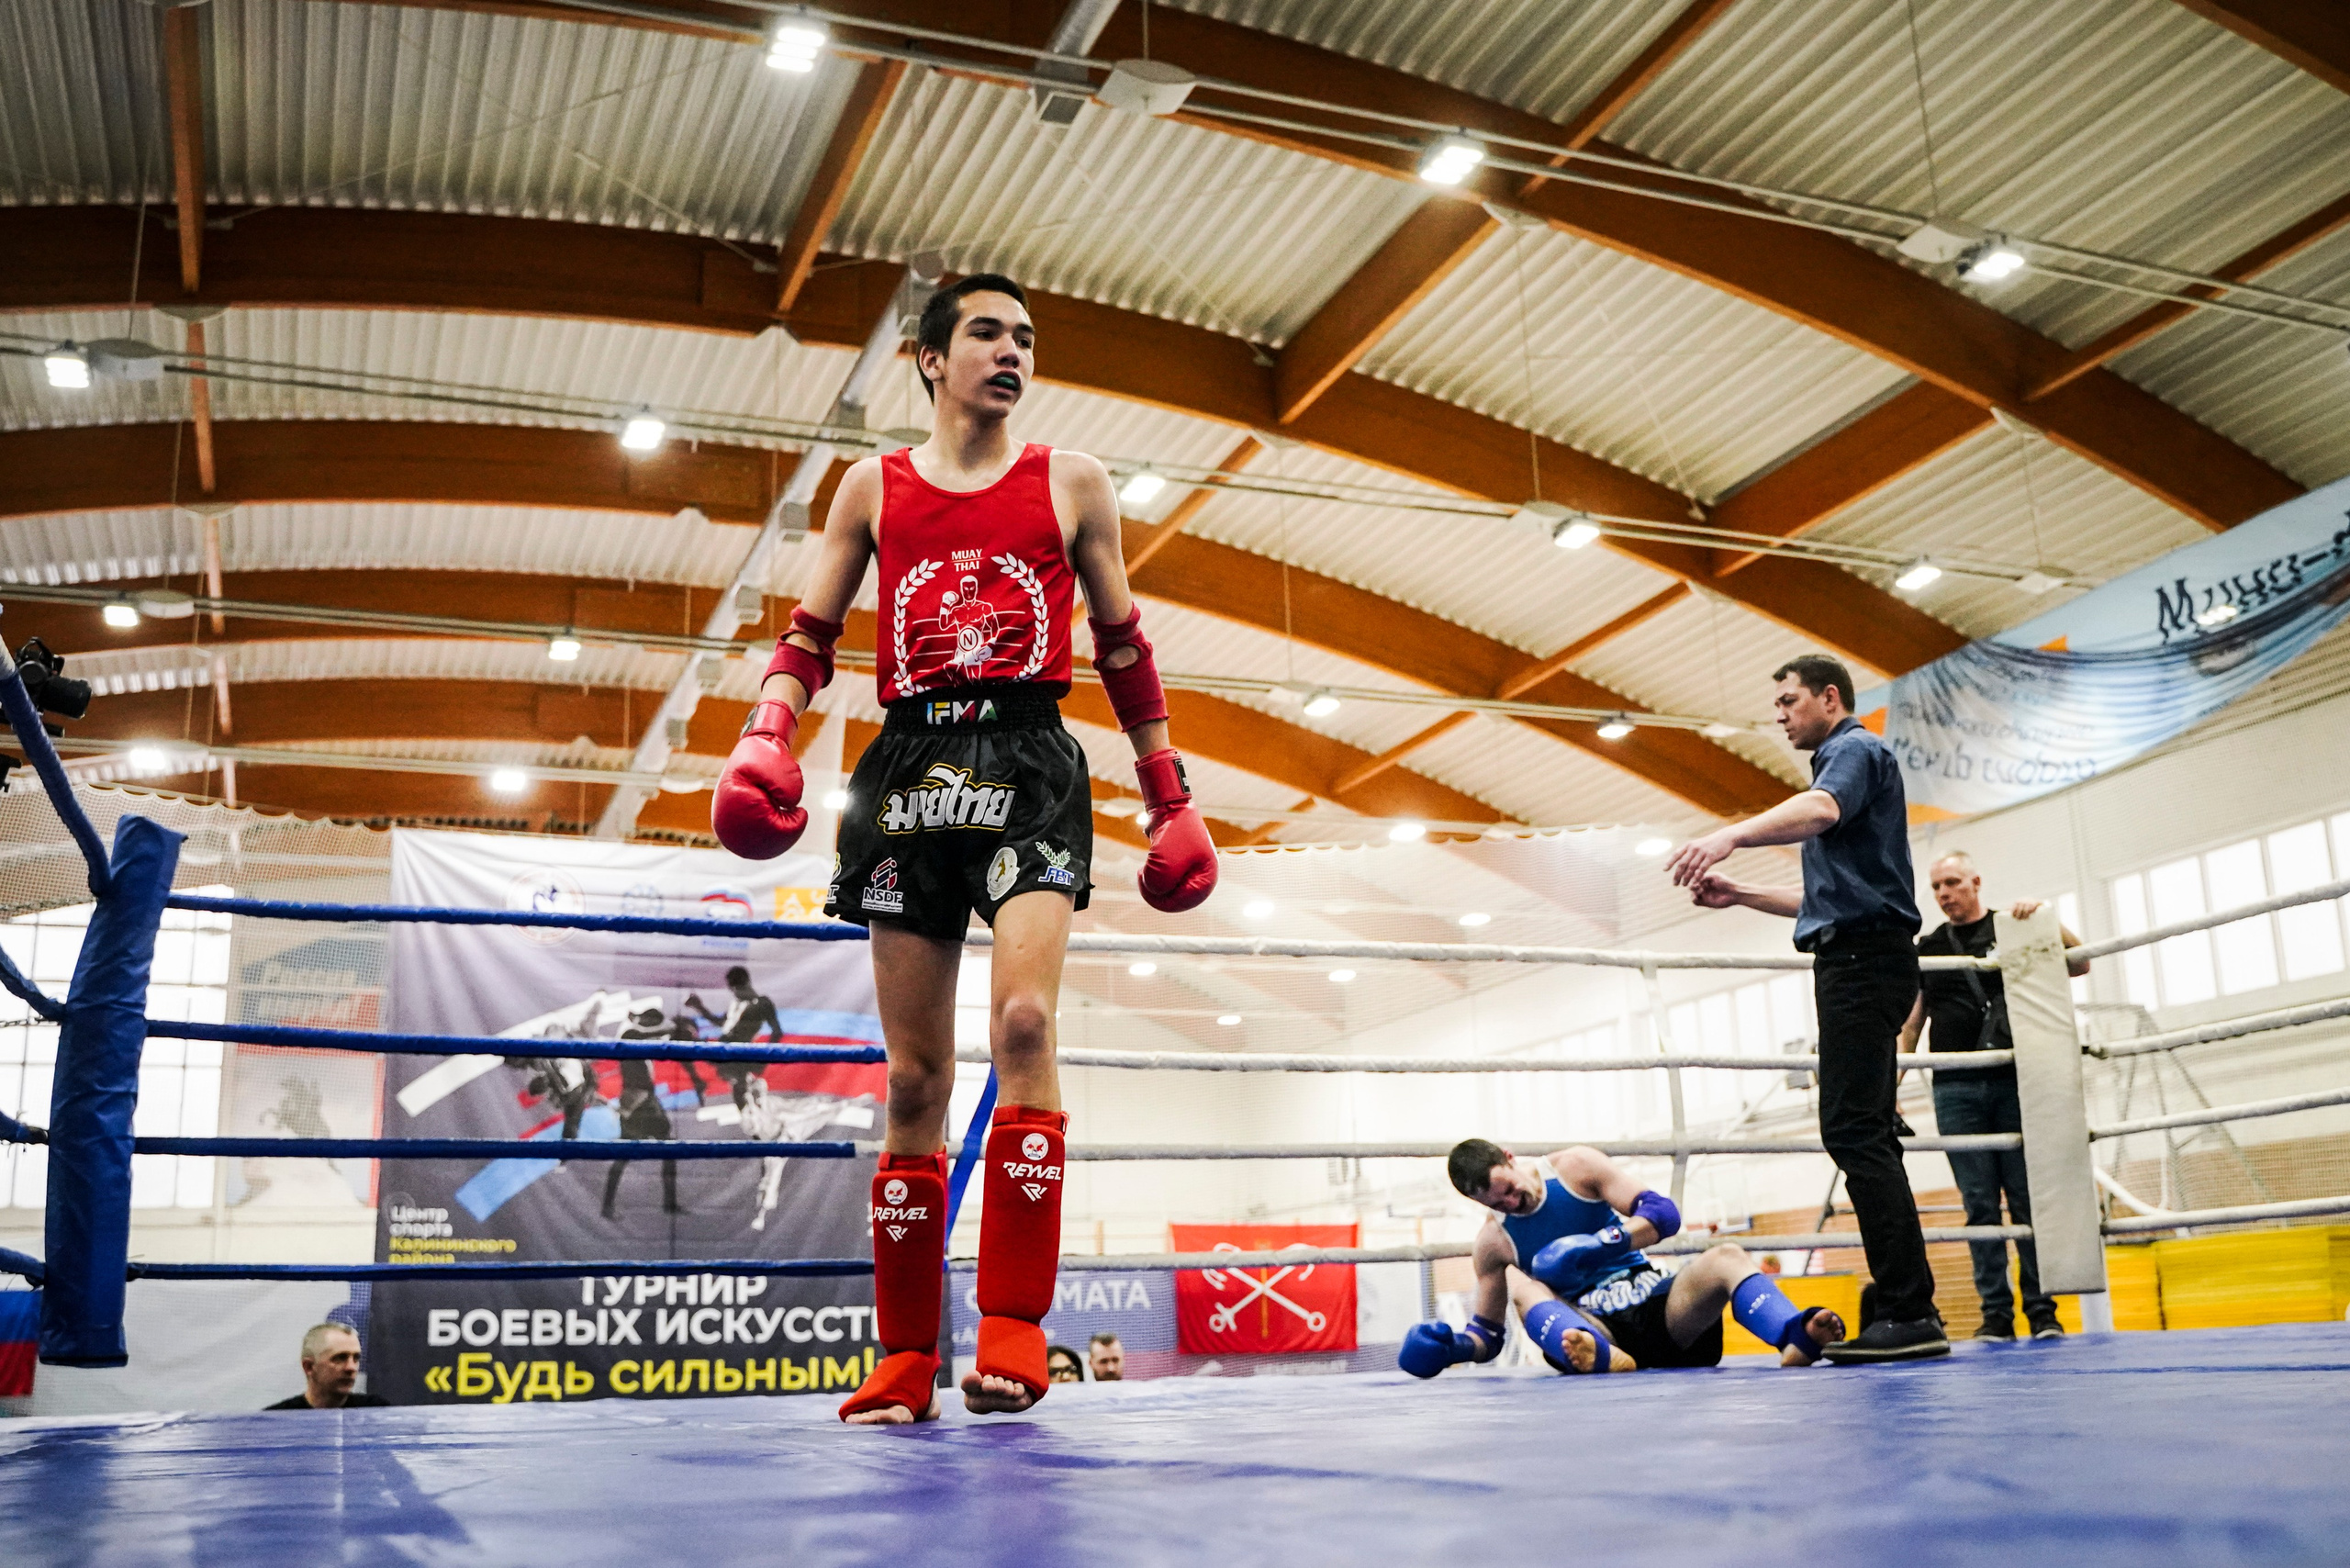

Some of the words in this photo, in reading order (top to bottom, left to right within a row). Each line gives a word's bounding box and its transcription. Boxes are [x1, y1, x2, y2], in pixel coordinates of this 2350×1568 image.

[951, 548, 982, 560] MUAY
[954, 560, 980, 572] THAI
[962, 633, 973, 646] N
[926, 699, 999, 725] IFMA
[863, 887, 903, 903] NSDF
[428, 1308, 643, 1347] БОЕВЫХ
[425, 1352, 595, 1404] «Будь
[609, 1346, 883, 1394] сильным!
